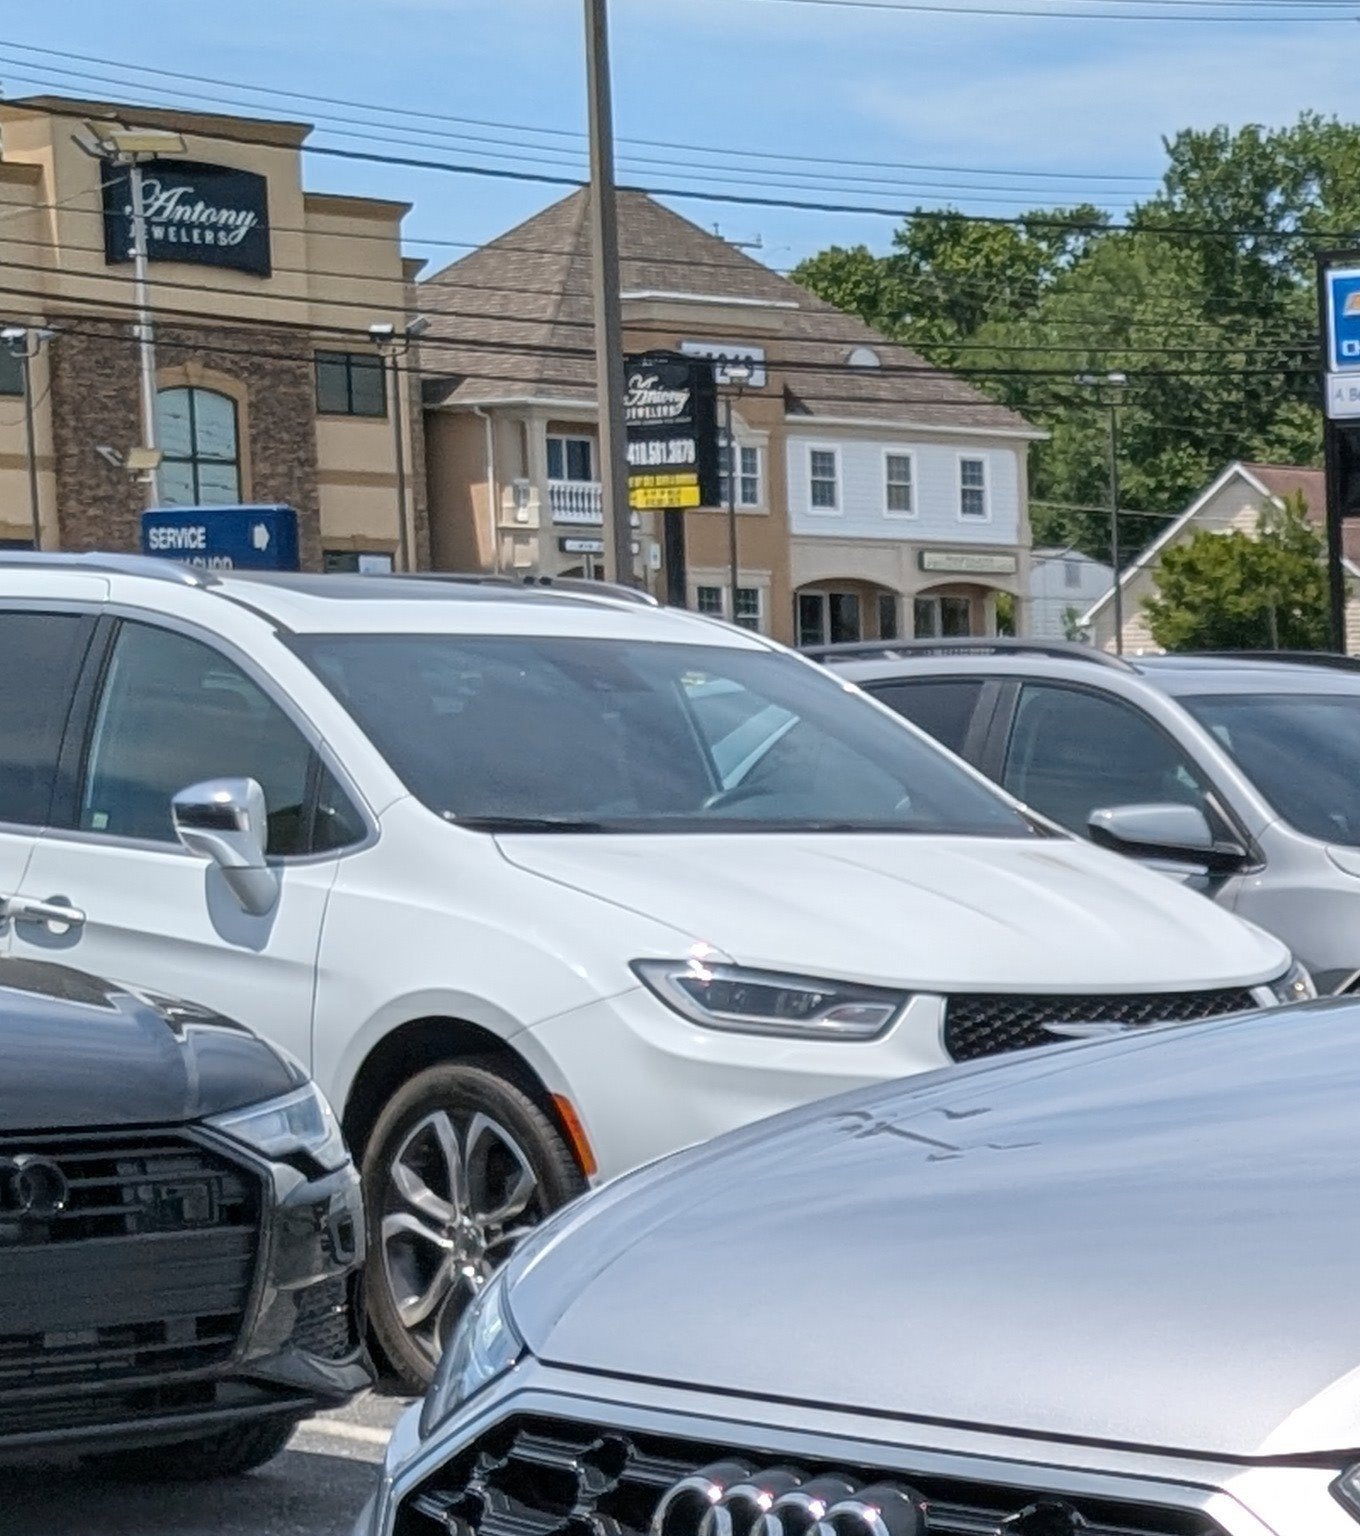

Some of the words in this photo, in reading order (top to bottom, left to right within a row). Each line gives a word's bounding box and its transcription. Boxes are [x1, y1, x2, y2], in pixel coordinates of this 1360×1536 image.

[125, 179, 258, 246] Antony
[129, 223, 229, 246] JWELERS
[1335, 388, 1345, 401] A
[149, 527, 207, 550] SERVICE
